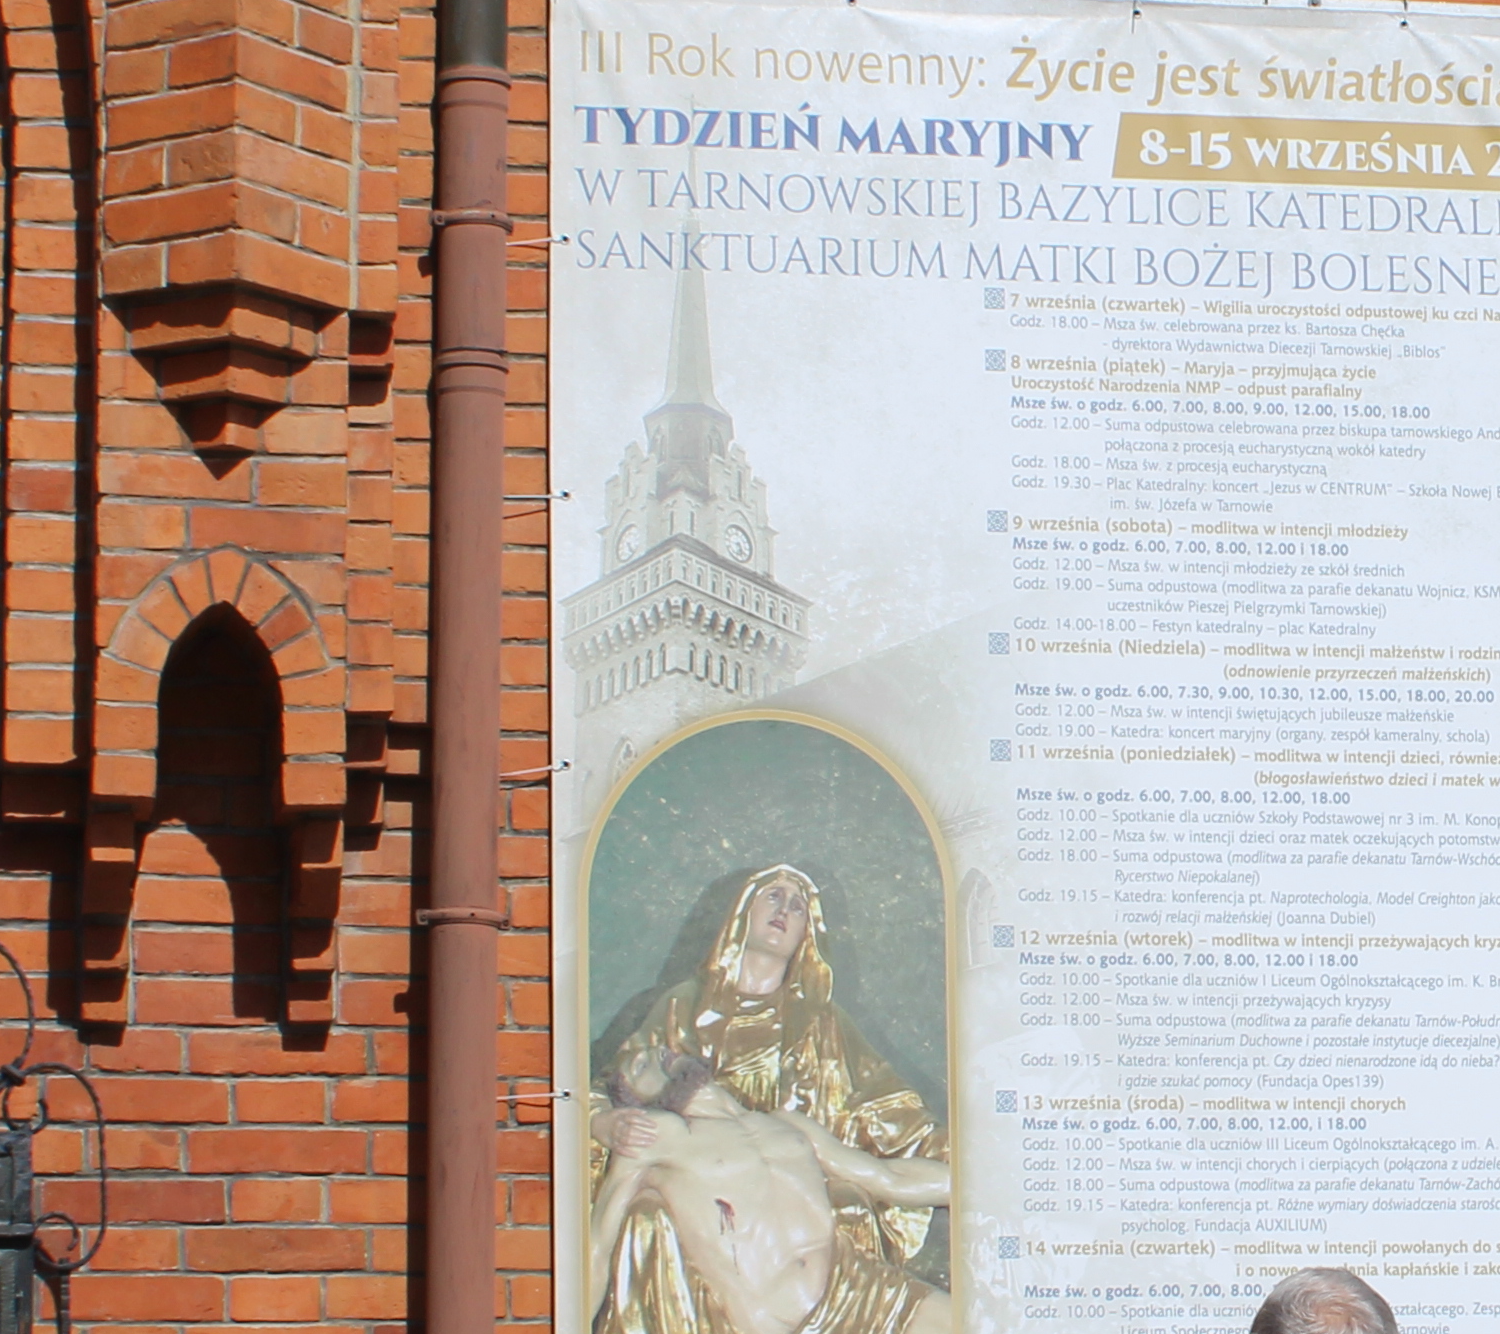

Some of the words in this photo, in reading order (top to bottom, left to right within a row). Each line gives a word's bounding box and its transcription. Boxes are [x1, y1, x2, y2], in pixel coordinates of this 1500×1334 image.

[580, 29, 621, 73] III
[647, 32, 735, 77] Rok
[754, 48, 985, 93] nowenny:
[1005, 36, 1135, 94] Życie
[1153, 50, 1241, 98] jest
[573, 106, 820, 149] TYDZIEŃ
[836, 118, 1092, 162] MARYJNY
[1139, 128, 1232, 169] 8-15
[1243, 132, 1475, 174] WRZEŚNIA
[573, 167, 623, 204] W
[636, 169, 979, 224] TARNOWSKIEJ
[998, 181, 1229, 226] BAZYLICE
[573, 230, 948, 277] SANKTUARIUM
[962, 243, 1115, 288] MATKI
[1133, 243, 1273, 296] BOŻEJ
[1009, 292, 1019, 307] 7
[1024, 293, 1096, 310] września
[1101, 295, 1185, 315] (czwartek)
[1202, 299, 1252, 317] Wigilia
[1256, 302, 1341, 318] uroczystości
[1344, 303, 1427, 322] odpustowej
[1431, 305, 1449, 320] ku
[1452, 306, 1478, 321] czci
[1009, 353, 1020, 369] 8
[1025, 355, 1097, 371] września
[1102, 356, 1165, 376] (piątek)
[1183, 360, 1235, 378] Maryja
[1251, 363, 1337, 380] przyjmująca
[1341, 364, 1376, 381] życie
[1010, 375, 1094, 393] Uroczystość
[1098, 377, 1180, 393] Narodzenia
[1185, 379, 1221, 394] NMP
[1236, 381, 1286, 398] odpust
[1290, 382, 1362, 401] parafialny
[1010, 395, 1046, 409] Msze
[1049, 396, 1072, 409] św.
[1075, 399, 1086, 410] o
[1089, 397, 1126, 414] godz.
[1131, 398, 1167, 413] 6.00,
[1171, 399, 1207, 414] 7.00,
[1212, 400, 1248, 415] 8.00,
[1252, 401, 1288, 416] 9.00,
[1293, 402, 1337, 417] 12.00,
[1342, 404, 1386, 418] 15.00,
[1391, 405, 1430, 419] 18.00
[1019, 929, 1040, 945] 12
[1044, 929, 1118, 945] września
[1123, 930, 1193, 949] (wtorek)
[1211, 932, 1280, 947] modlitwa
[1282, 936, 1297, 947] w
[1300, 932, 1353, 950] intencji
[1357, 933, 1469, 951] przeżywających
[1018, 991, 1056, 1006] Godz.
[1062, 991, 1100, 1006] 12.00
[1115, 992, 1148, 1006] Msza
[1151, 992, 1172, 1006] św.
[1176, 996, 1188, 1006] w
[1191, 992, 1238, 1009] intencji
[1242, 993, 1341, 1010] przeżywających
[1344, 993, 1391, 1011] kryzysy
[1025, 1240, 1046, 1256] 14
[1050, 1239, 1124, 1255] września
[1129, 1239, 1215, 1257] (czwartek)
[1233, 1240, 1302, 1255] modlitwa
[1305, 1243, 1320, 1254] w
[1323, 1239, 1377, 1257] intencji
[1381, 1239, 1468, 1257] powołanych
[1471, 1238, 1491, 1253] do
